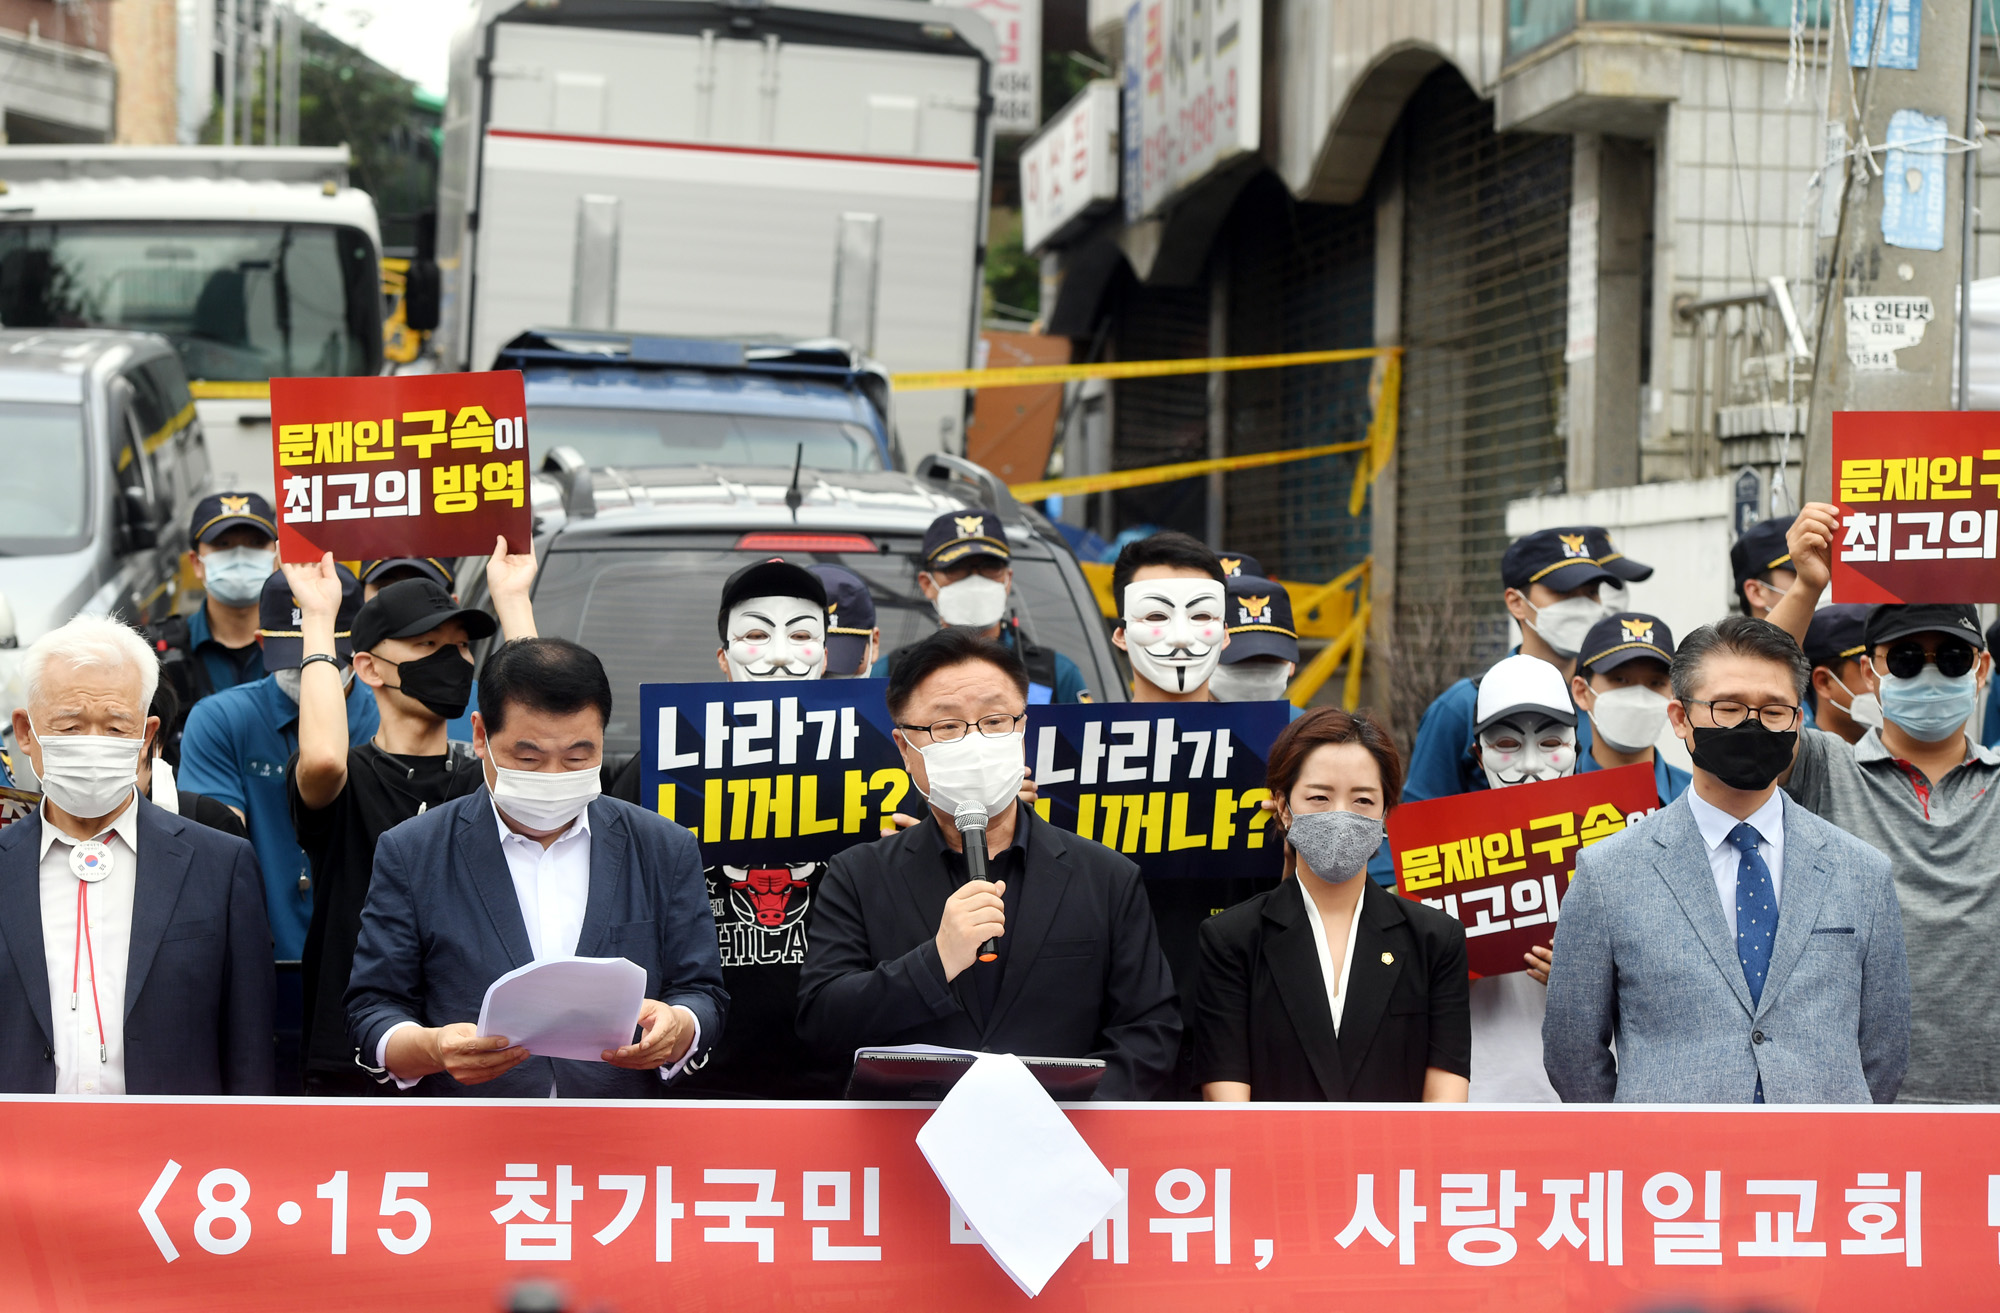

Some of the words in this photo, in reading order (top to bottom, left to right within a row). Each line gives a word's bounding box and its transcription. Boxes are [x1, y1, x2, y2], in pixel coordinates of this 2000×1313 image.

[1874, 302, 1929, 320] 인터넷
[1856, 354, 1889, 365] 1544
[279, 418, 395, 467] 문재인
[401, 405, 524, 459] 구속이
[283, 468, 421, 524] 최고의
[432, 460, 524, 514] 방역
[1840, 456, 1973, 503] 문재인
[1840, 509, 1998, 562] 최고의
[657, 697, 860, 771] 나라가
[1034, 717, 1234, 786] 나라가
[656, 767, 910, 844] 니꺼냐?
[1400, 828, 1527, 892] 문재인
[716, 920, 809, 967] HICA
[489, 1163, 883, 1263] 참가국민
[1333, 1169, 1923, 1268] 사랑제일교회
